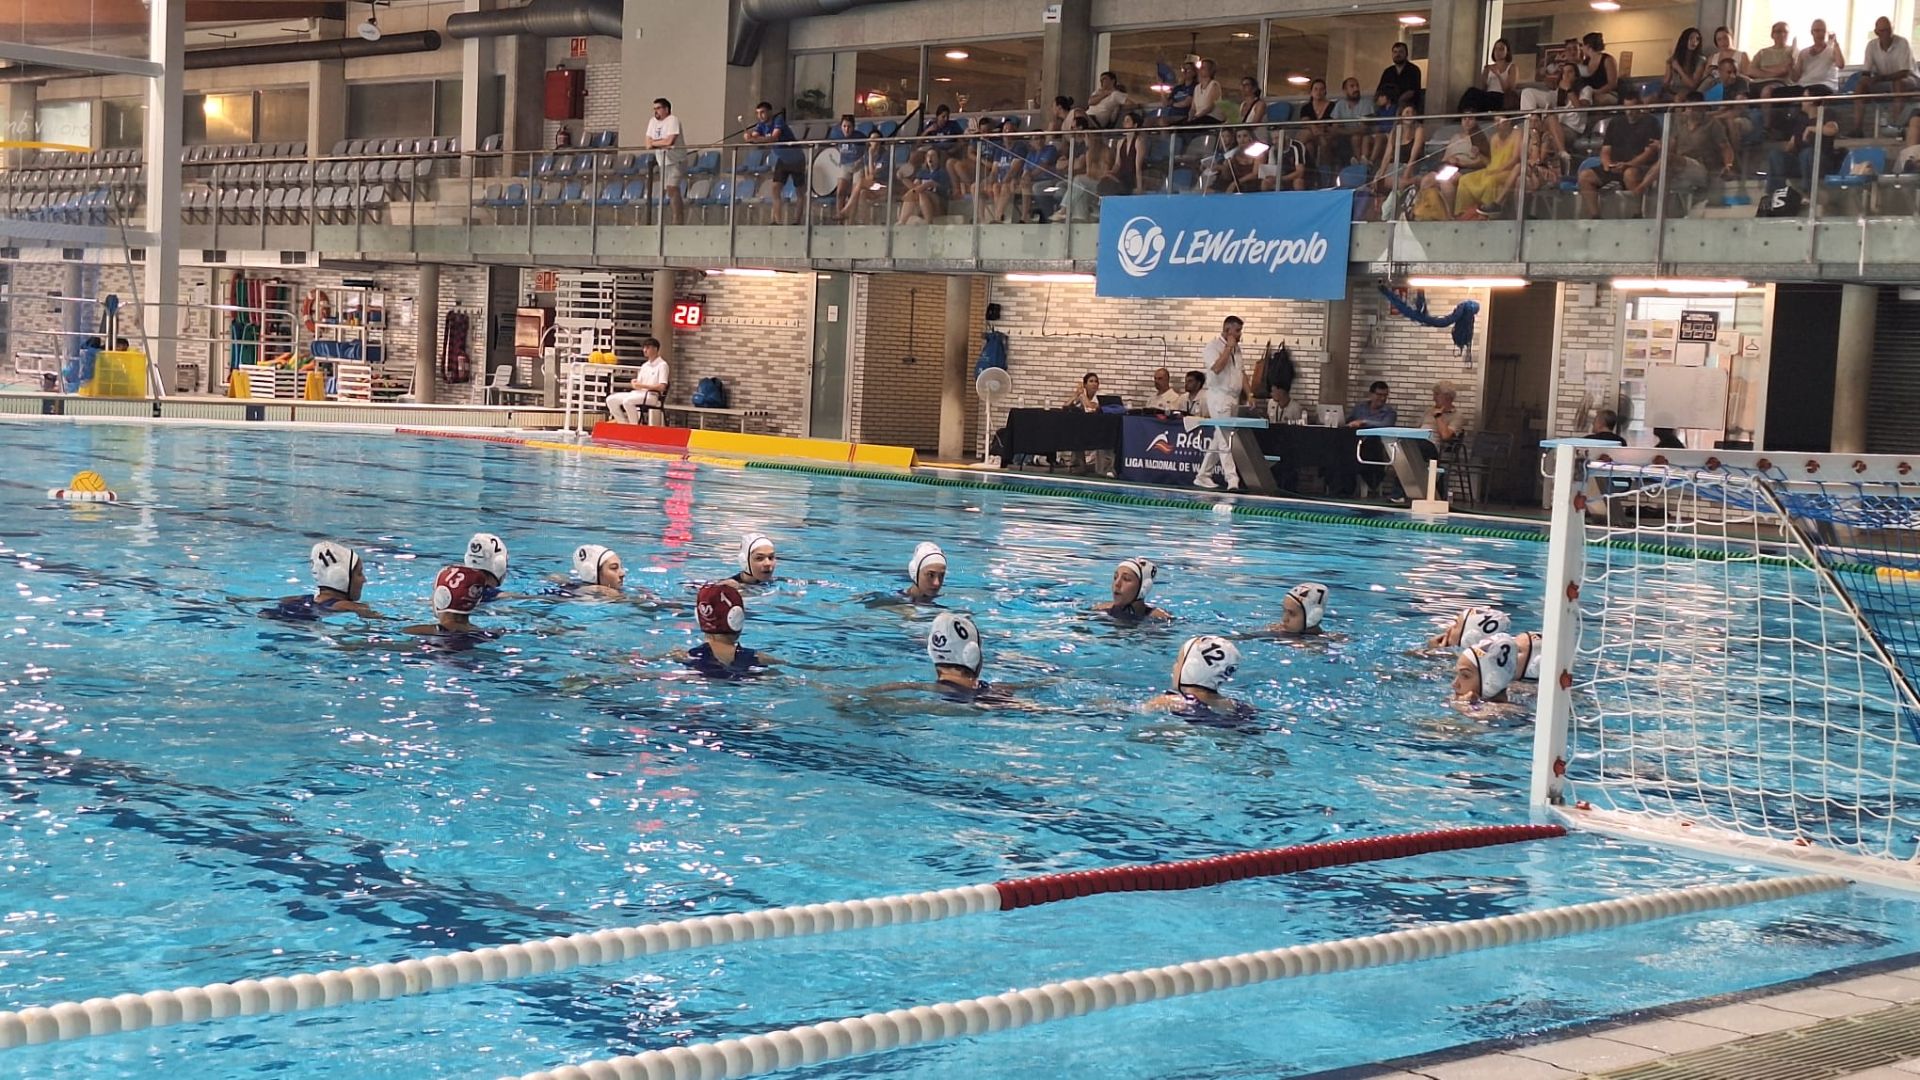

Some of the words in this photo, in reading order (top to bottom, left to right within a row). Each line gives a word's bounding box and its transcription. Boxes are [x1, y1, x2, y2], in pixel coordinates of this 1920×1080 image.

[1168, 228, 1328, 273] LEWaterpolo
[674, 305, 700, 325] 28
[1125, 457, 1143, 468] LIGA
[1179, 461, 1190, 473] DE
[490, 538, 502, 553] 2
[578, 548, 587, 562] 9
[318, 548, 337, 567] 11
[445, 567, 465, 589] 13
[720, 591, 732, 607] 1
[1316, 589, 1325, 605] 7
[954, 621, 969, 640] 6
[1478, 615, 1499, 634] 10
[1201, 643, 1225, 667] 12
[1497, 644, 1511, 667] 3
